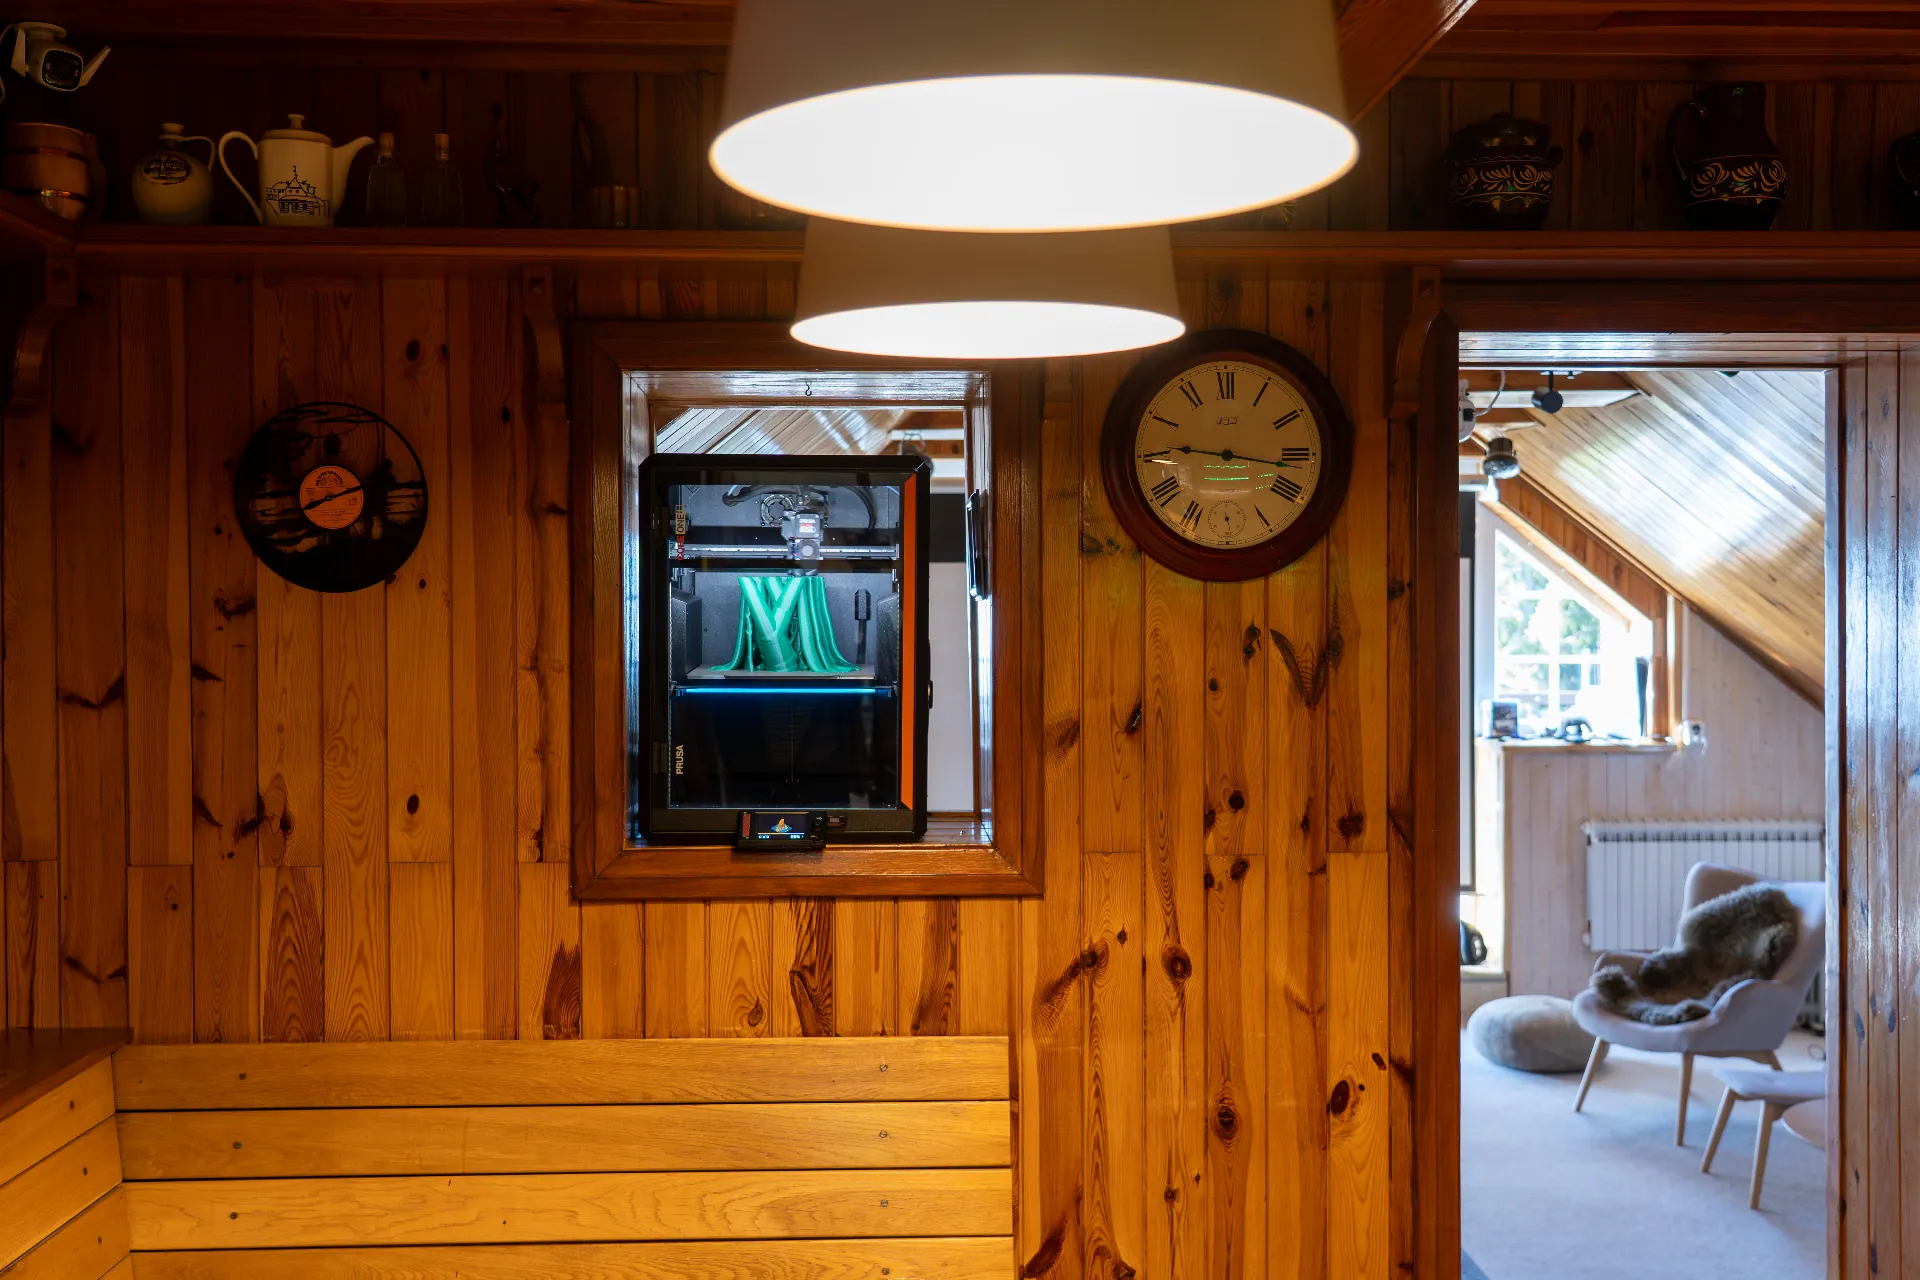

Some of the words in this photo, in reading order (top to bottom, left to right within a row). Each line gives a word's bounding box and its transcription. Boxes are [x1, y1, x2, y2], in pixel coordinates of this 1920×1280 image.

[1178, 381, 1204, 411] XI
[1217, 372, 1235, 400] XII
[1253, 382, 1269, 407] I
[1152, 412, 1180, 432] X
[1272, 409, 1300, 431] II
[1282, 448, 1309, 461] III
[1150, 475, 1182, 508] VIII
[677, 513, 685, 533] ONE
[1179, 500, 1204, 532] VII
[1254, 504, 1272, 528] V
[676, 535, 685, 561] CORE
[675, 745, 684, 775] PRUSA
